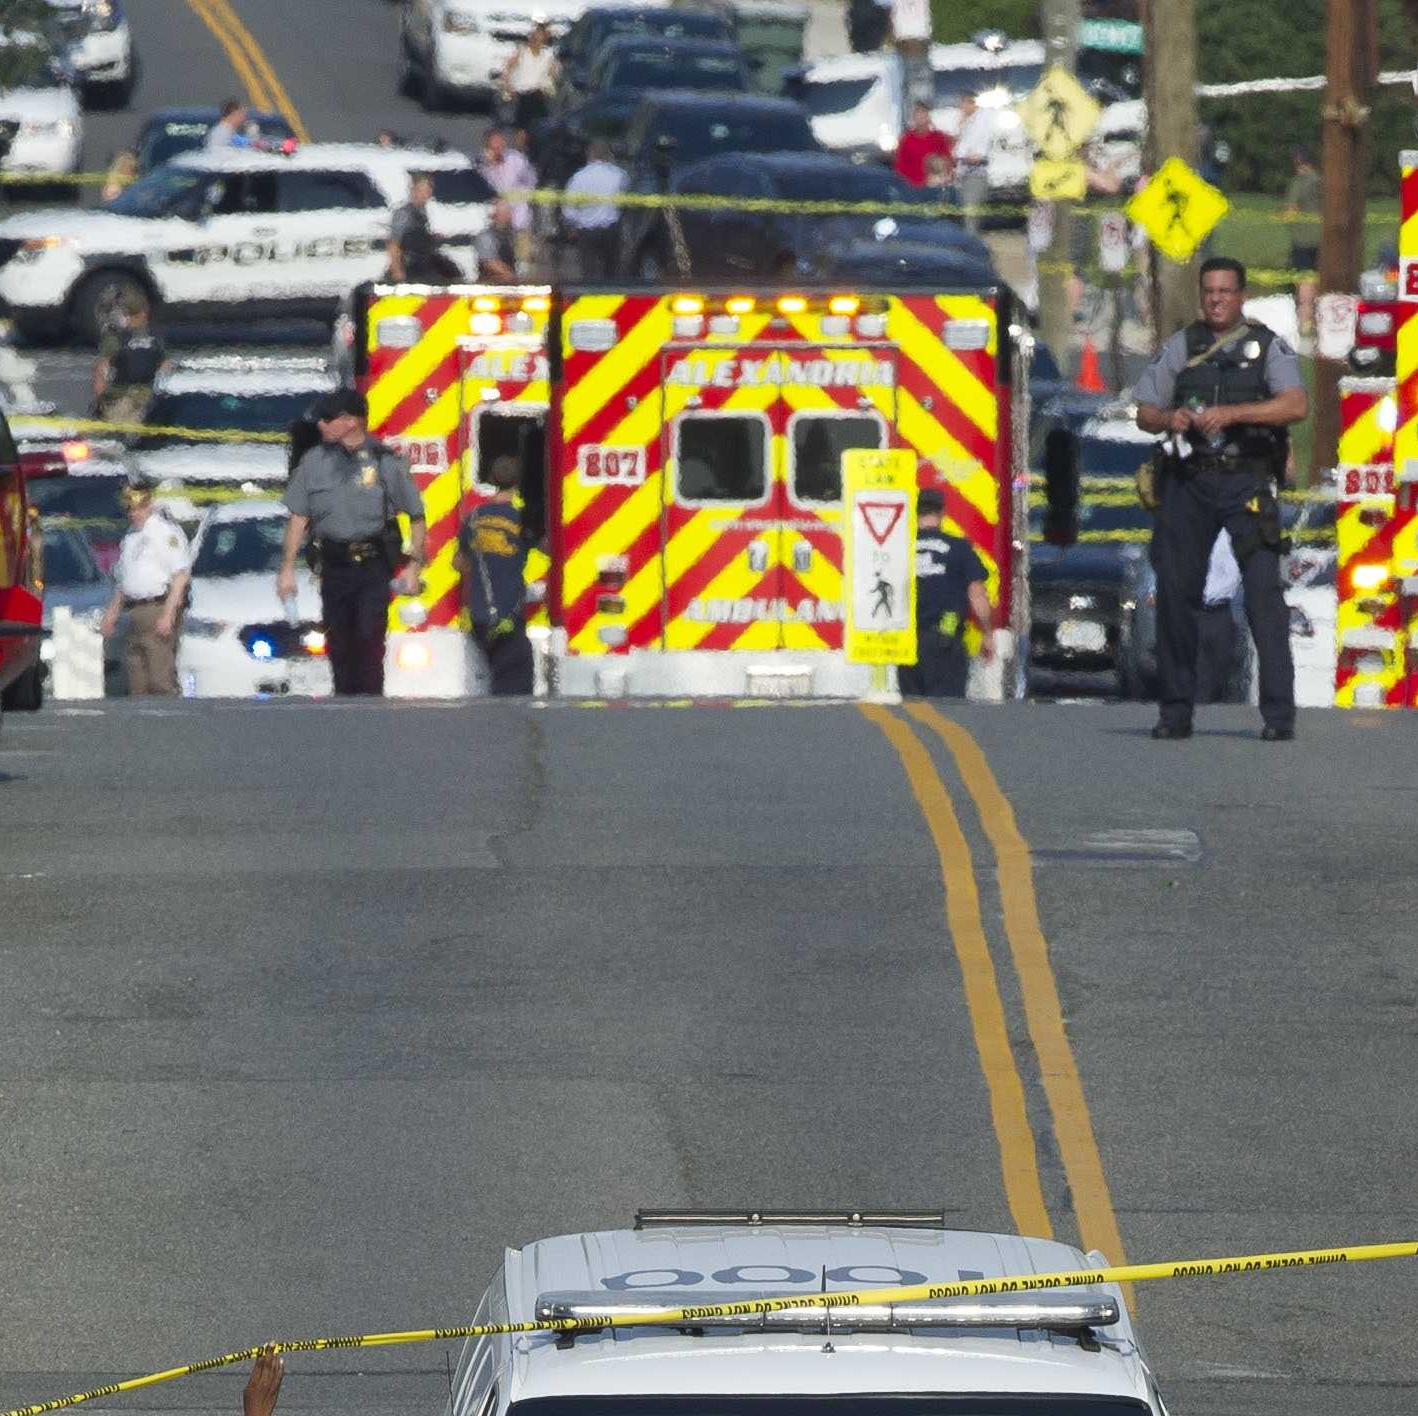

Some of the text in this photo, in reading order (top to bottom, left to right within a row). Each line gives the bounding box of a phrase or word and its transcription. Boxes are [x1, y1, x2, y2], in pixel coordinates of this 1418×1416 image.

[195, 238, 369, 266] POLICE
[666, 359, 895, 387] ALEXANDRIA
[586, 452, 639, 477] 807
